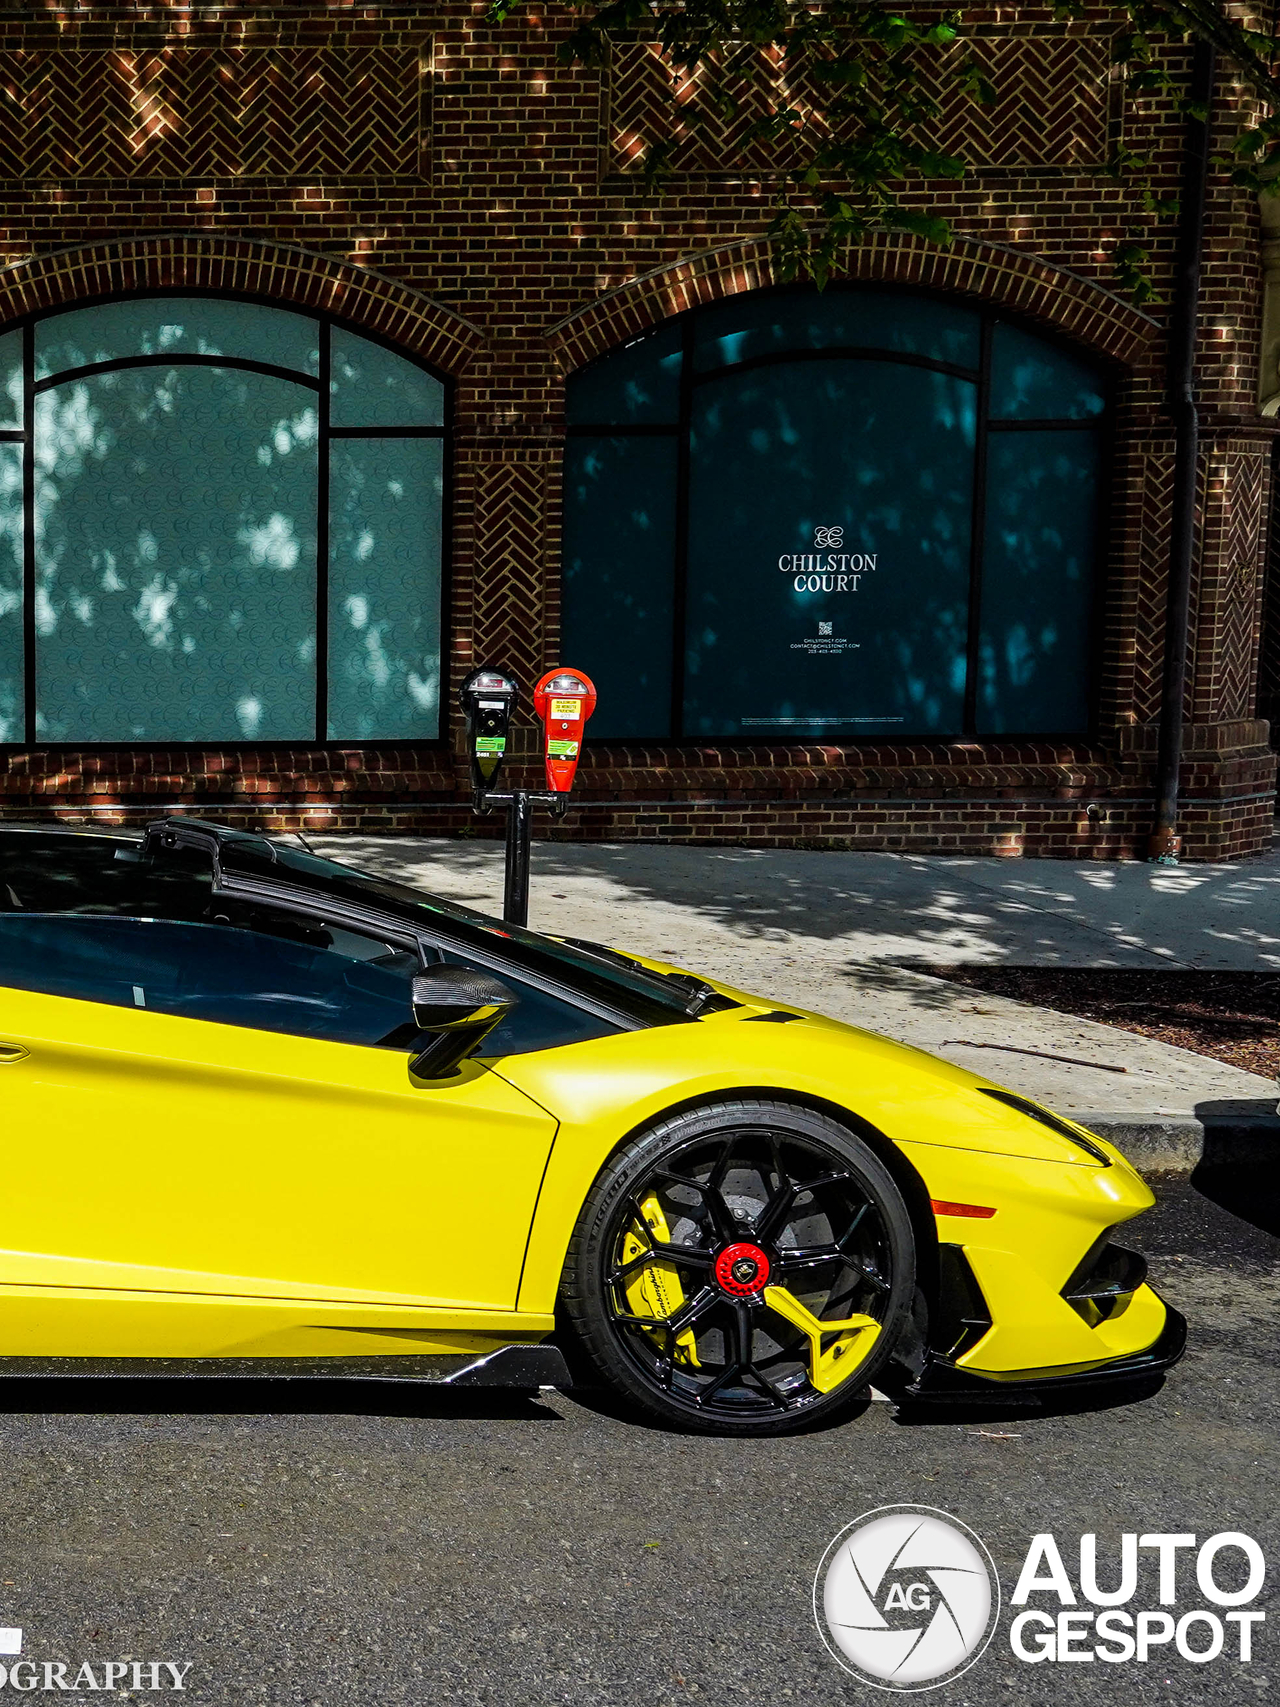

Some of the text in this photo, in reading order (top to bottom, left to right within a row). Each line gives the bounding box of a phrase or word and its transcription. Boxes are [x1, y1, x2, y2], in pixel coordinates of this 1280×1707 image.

[778, 554, 878, 572] CHILSTON
[794, 574, 861, 592] COURT
[590, 1170, 631, 1239] MICHELIN
